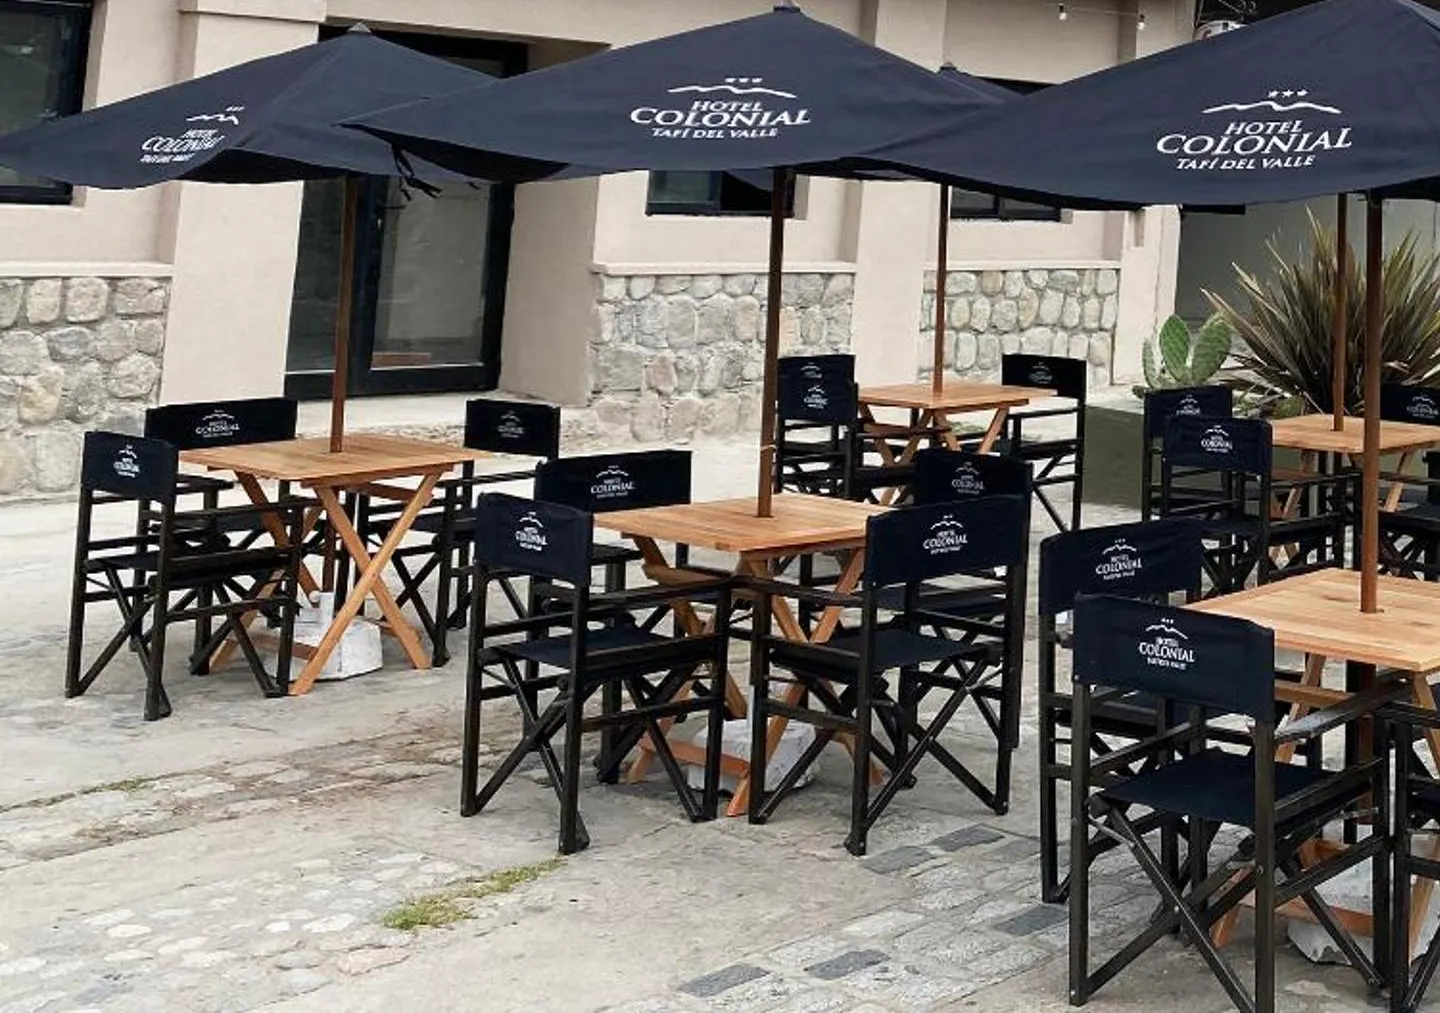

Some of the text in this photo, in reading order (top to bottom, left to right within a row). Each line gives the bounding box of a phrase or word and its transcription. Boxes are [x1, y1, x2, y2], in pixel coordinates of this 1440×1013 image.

[691, 100, 763, 112] HOTEL
[630, 107, 811, 128] COLONIAL
[693, 129, 725, 139] DEL
[730, 127, 778, 138] VALLE
[1225, 120, 1304, 135] HOTEL
[1156, 127, 1353, 156] COLONIAL
[1220, 157, 1256, 170] DEL
[1262, 155, 1317, 169] VALLE
[1138, 641, 1196, 663] COLONIAL
